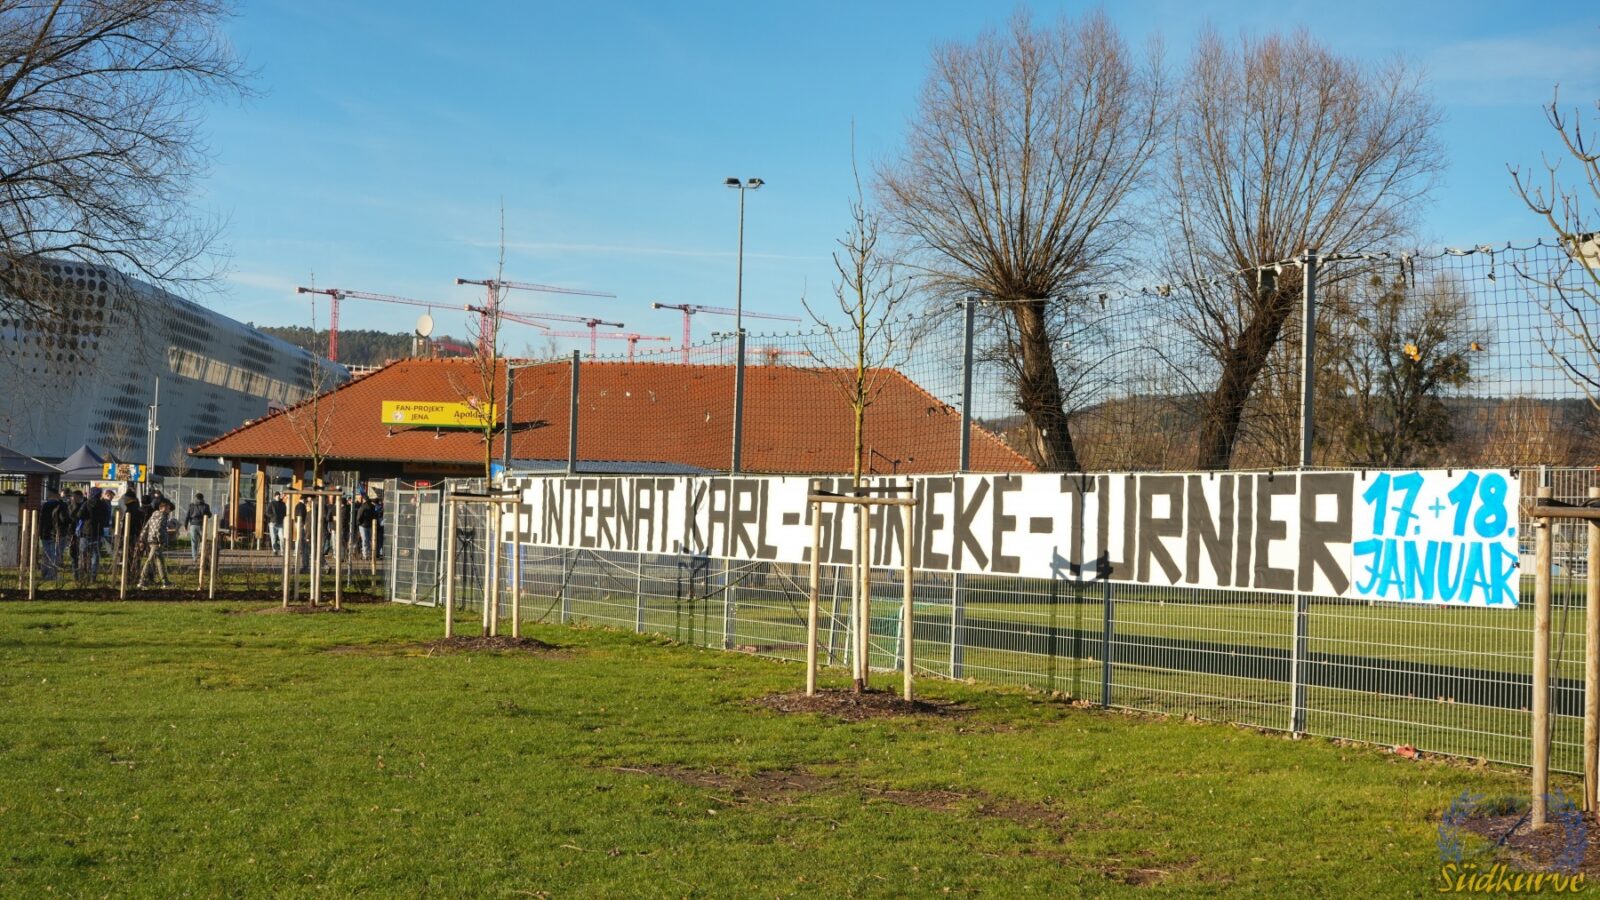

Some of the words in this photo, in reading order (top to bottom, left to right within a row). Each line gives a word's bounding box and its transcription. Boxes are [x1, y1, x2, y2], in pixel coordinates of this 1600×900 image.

[395, 404, 444, 413] FAN-PROJEKT
[411, 412, 429, 421] JENA
[1353, 538, 1519, 606] JANUAR
